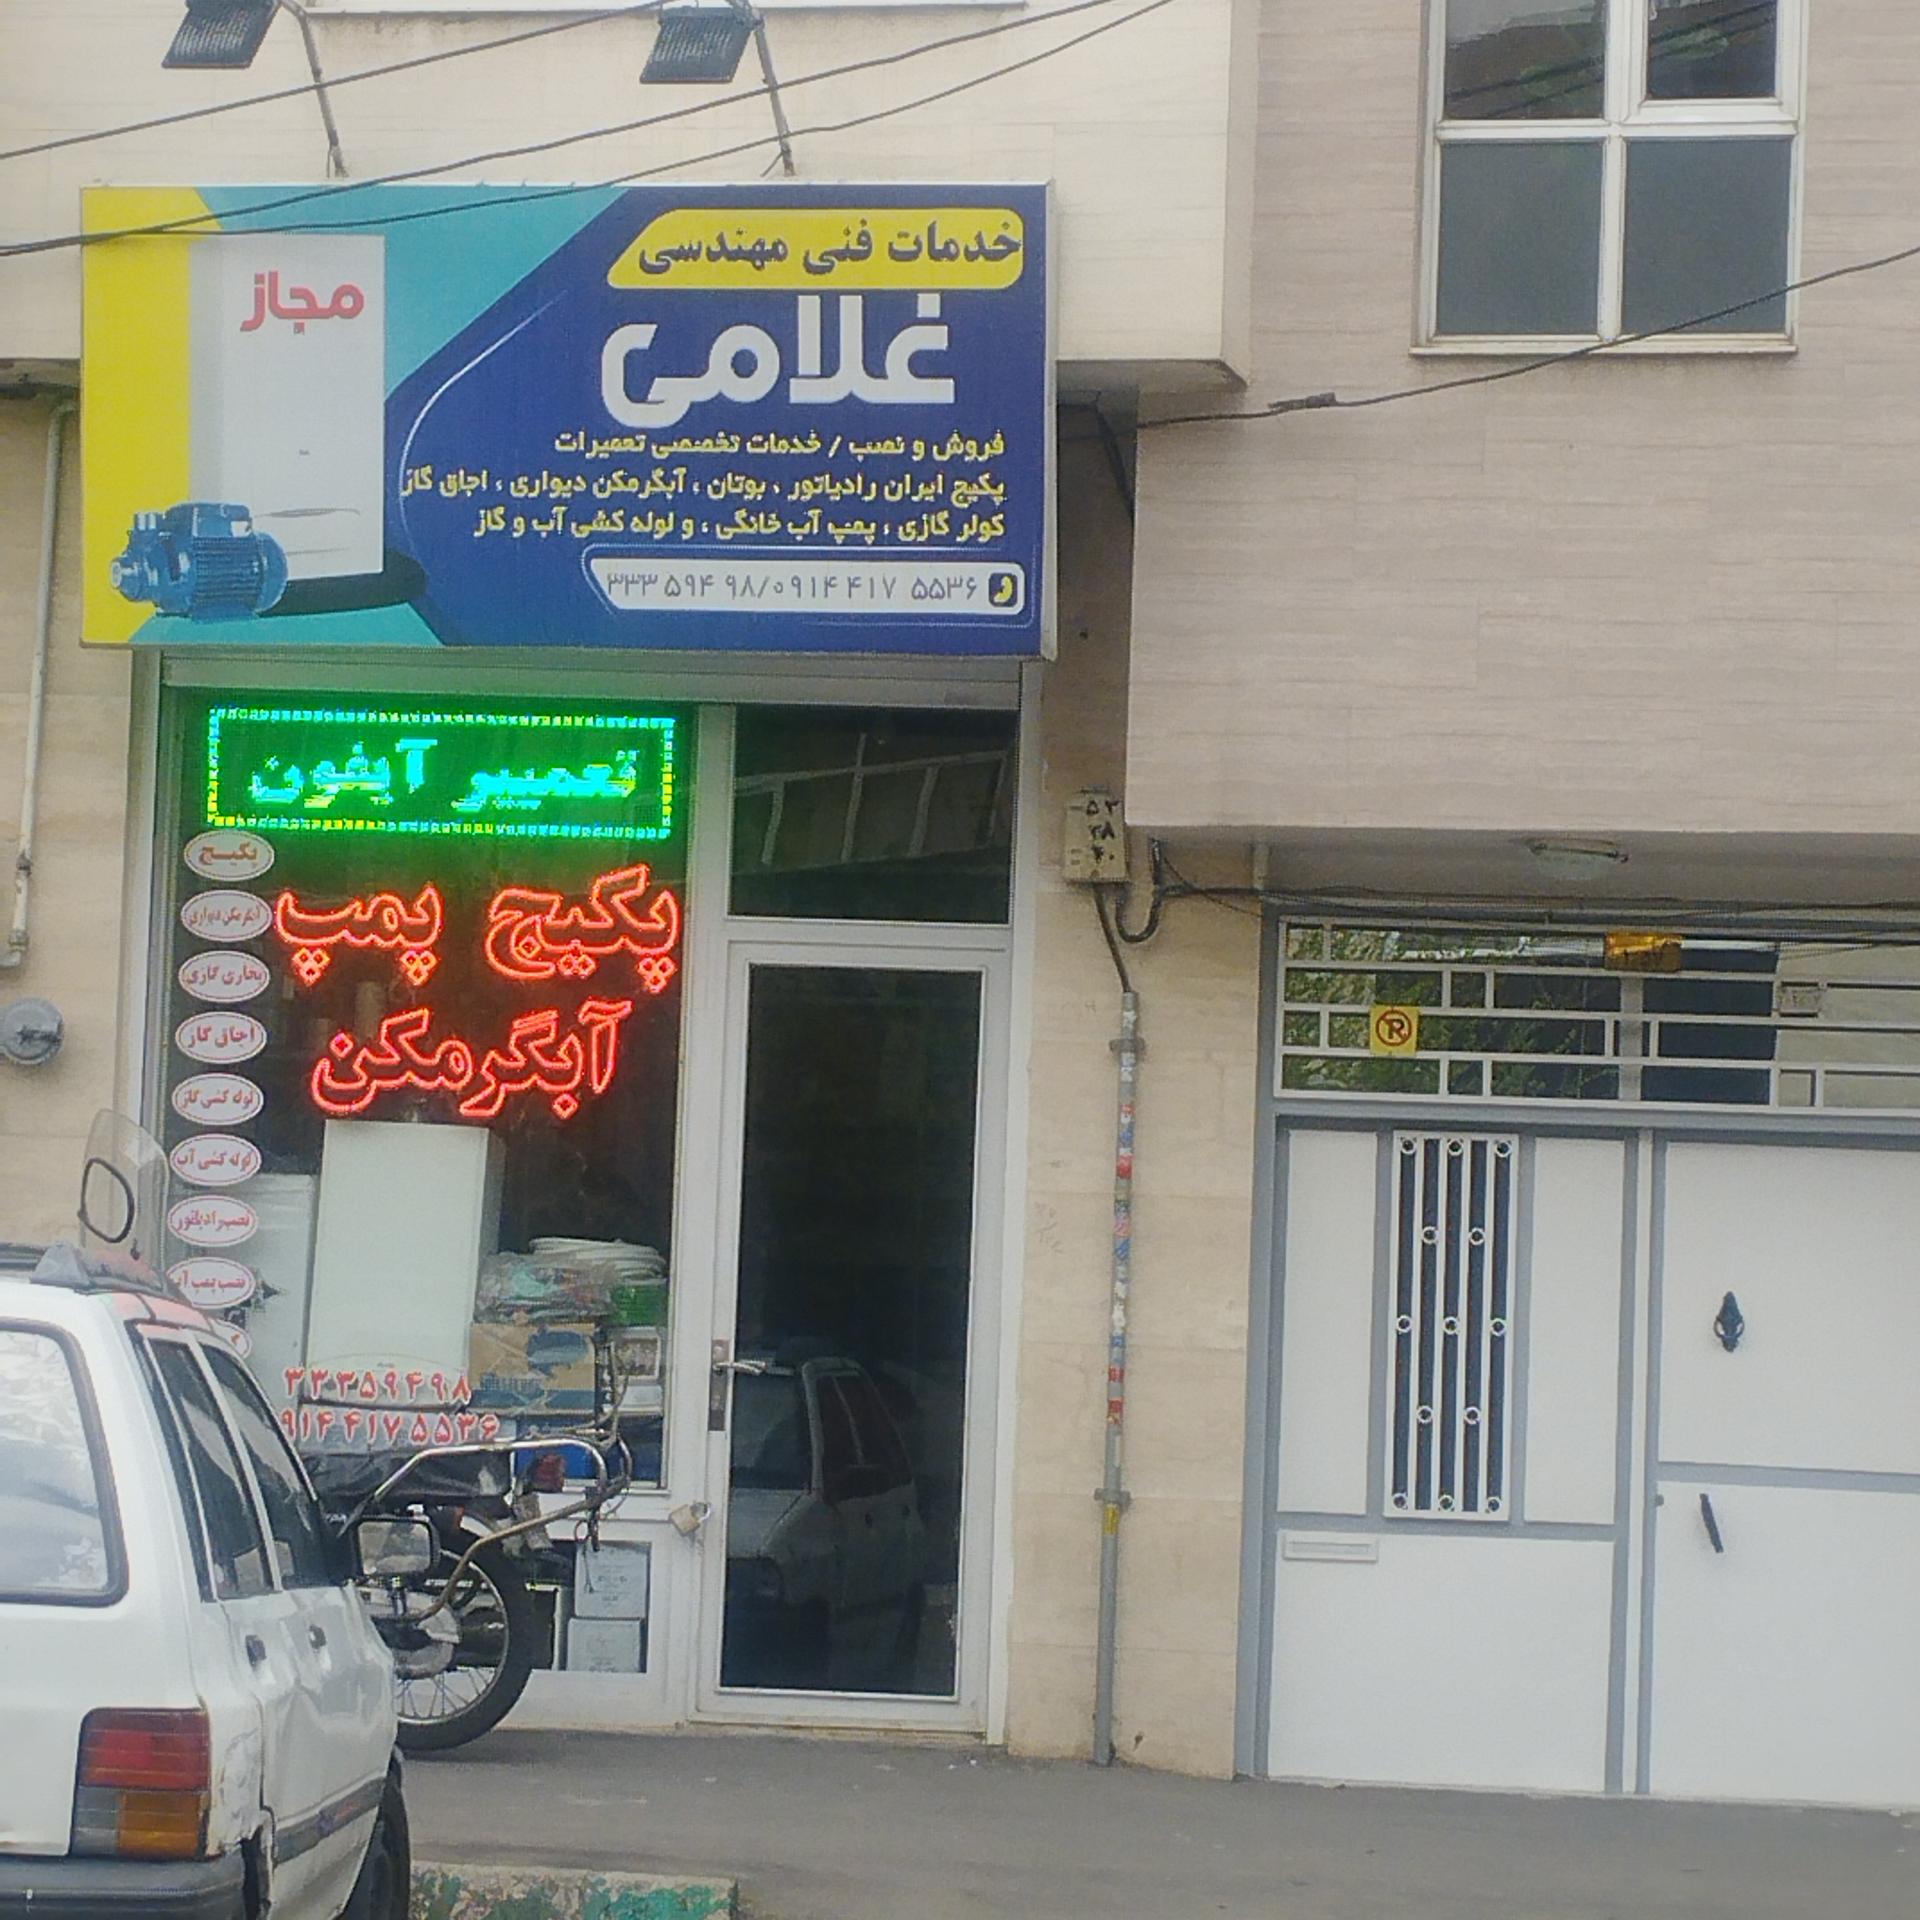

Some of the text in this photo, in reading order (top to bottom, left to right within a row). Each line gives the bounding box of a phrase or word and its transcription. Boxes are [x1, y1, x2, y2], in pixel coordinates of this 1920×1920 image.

[639, 218, 1022, 275] خدمات فنی مهندسی
[240, 270, 365, 334] مجاز
[602, 292, 955, 429] غلامی
[555, 431, 647, 459] تعمیرات
[746, 429, 821, 455] خدمات
[849, 435, 905, 462] نصب
[912, 439, 925, 461] و
[933, 429, 1004, 461] فروش
[402, 465, 432, 496] گاز
[440, 469, 487, 497] اجاق
[510, 470, 586, 497] دیواری
[593, 467, 686, 500] آبگرمکن
[707, 473, 766, 500] بوتان
[788, 473, 876, 502] رادیاتور
[884, 473, 942, 502] ایران
[951, 473, 1006, 508] پکیج
[474, 507, 505, 538] گاز
[512, 516, 526, 538] و
[532, 506, 567, 538] آب
[571, 509, 624, 539] کشی
[630, 511, 673, 540] لوله
[682, 518, 694, 540] و
[716, 508, 781, 540] خانگی
[787, 508, 822, 541] آب
[828, 521, 876, 544] پمپ
[898, 510, 949, 541] گازی
[954, 512, 1004, 542] کولر
[199, 842, 258, 866] پکیج
[274, 863, 679, 992] پکیج پمپ
[223, 965, 262, 986] بخاری
[188, 1025, 212, 1048] گاز
[312, 1000, 632, 1118] آبگرمکن
